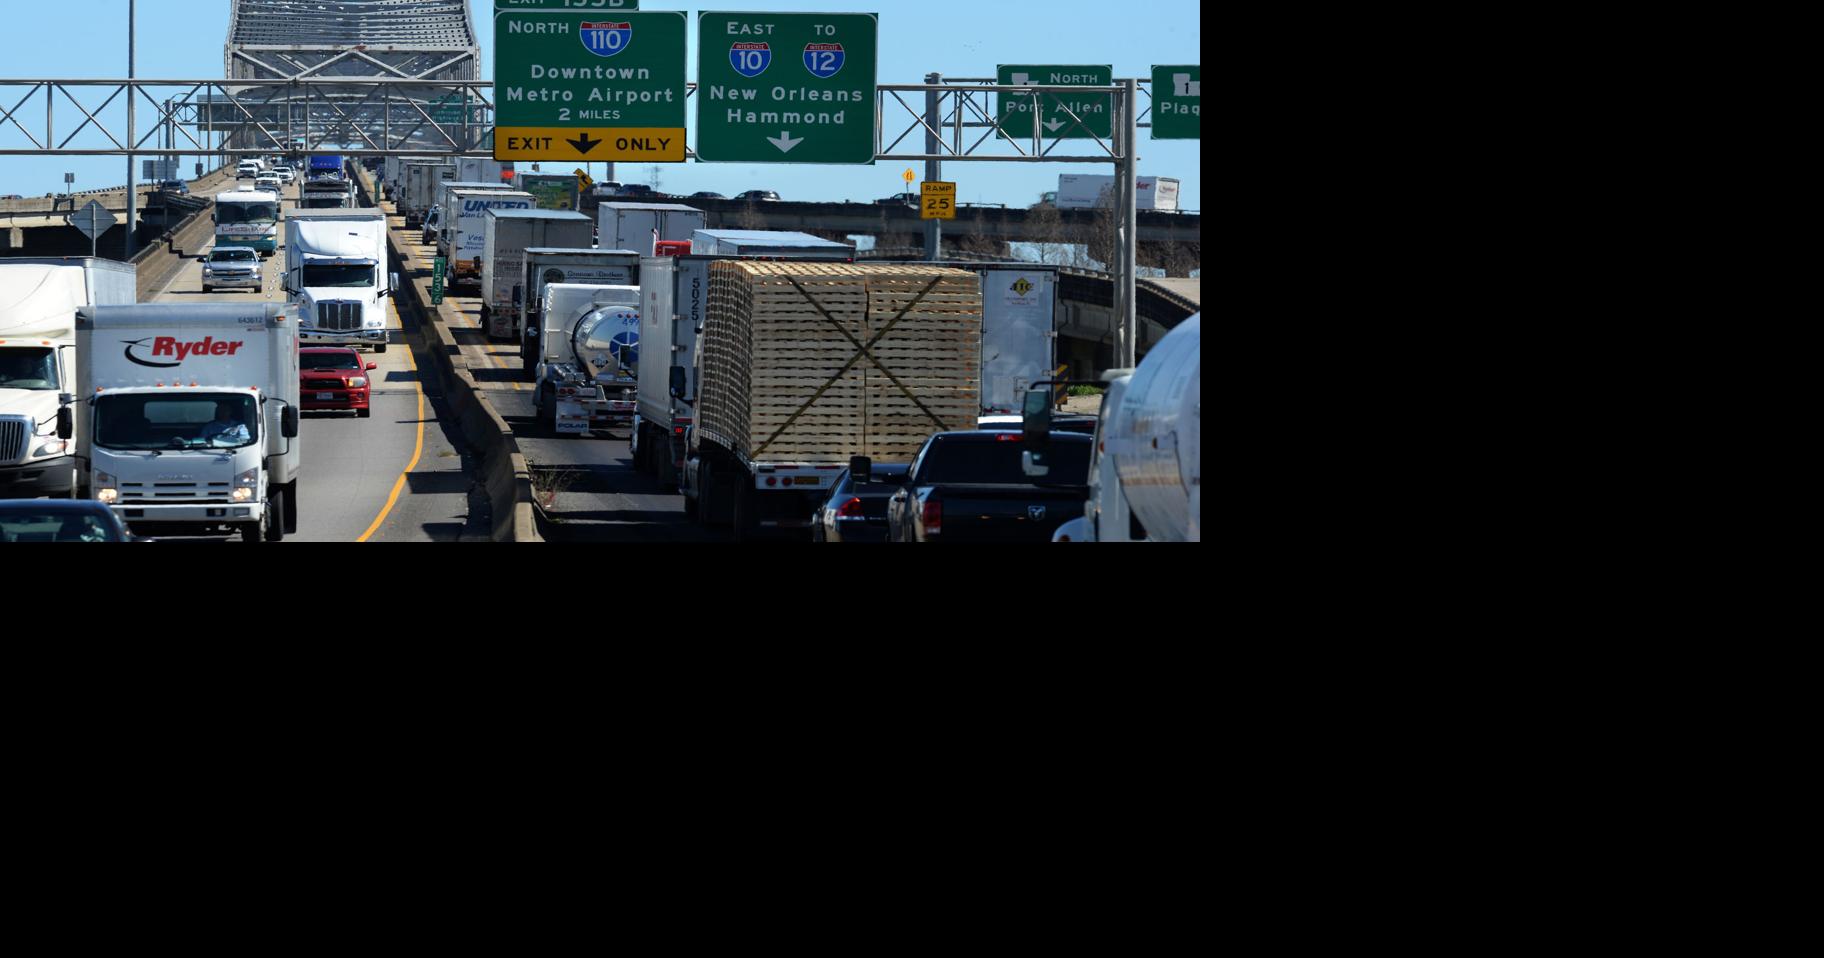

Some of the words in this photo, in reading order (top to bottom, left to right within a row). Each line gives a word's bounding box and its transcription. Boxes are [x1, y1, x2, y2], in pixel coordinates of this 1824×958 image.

[508, 20, 569, 34] NORTH
[727, 21, 775, 35] EAST
[814, 24, 836, 36] TO
[590, 30, 622, 49] 110
[738, 51, 763, 70] 10
[811, 52, 836, 71] 12
[531, 64, 650, 80] Downtown
[1050, 72, 1098, 84] NORTH
[506, 87, 574, 102] Metro
[588, 87, 673, 105] Airport
[710, 85, 758, 100] New
[771, 86, 863, 101] Orleans
[558, 108, 571, 121] 2
[579, 110, 621, 120] MILES
[727, 108, 845, 124] Hammond
[507, 137, 553, 150] EXIT
[615, 137, 672, 151] ONLY
[927, 198, 950, 210] 25
[691, 277, 701, 321] 5025
[152, 336, 244, 361] Ryder
